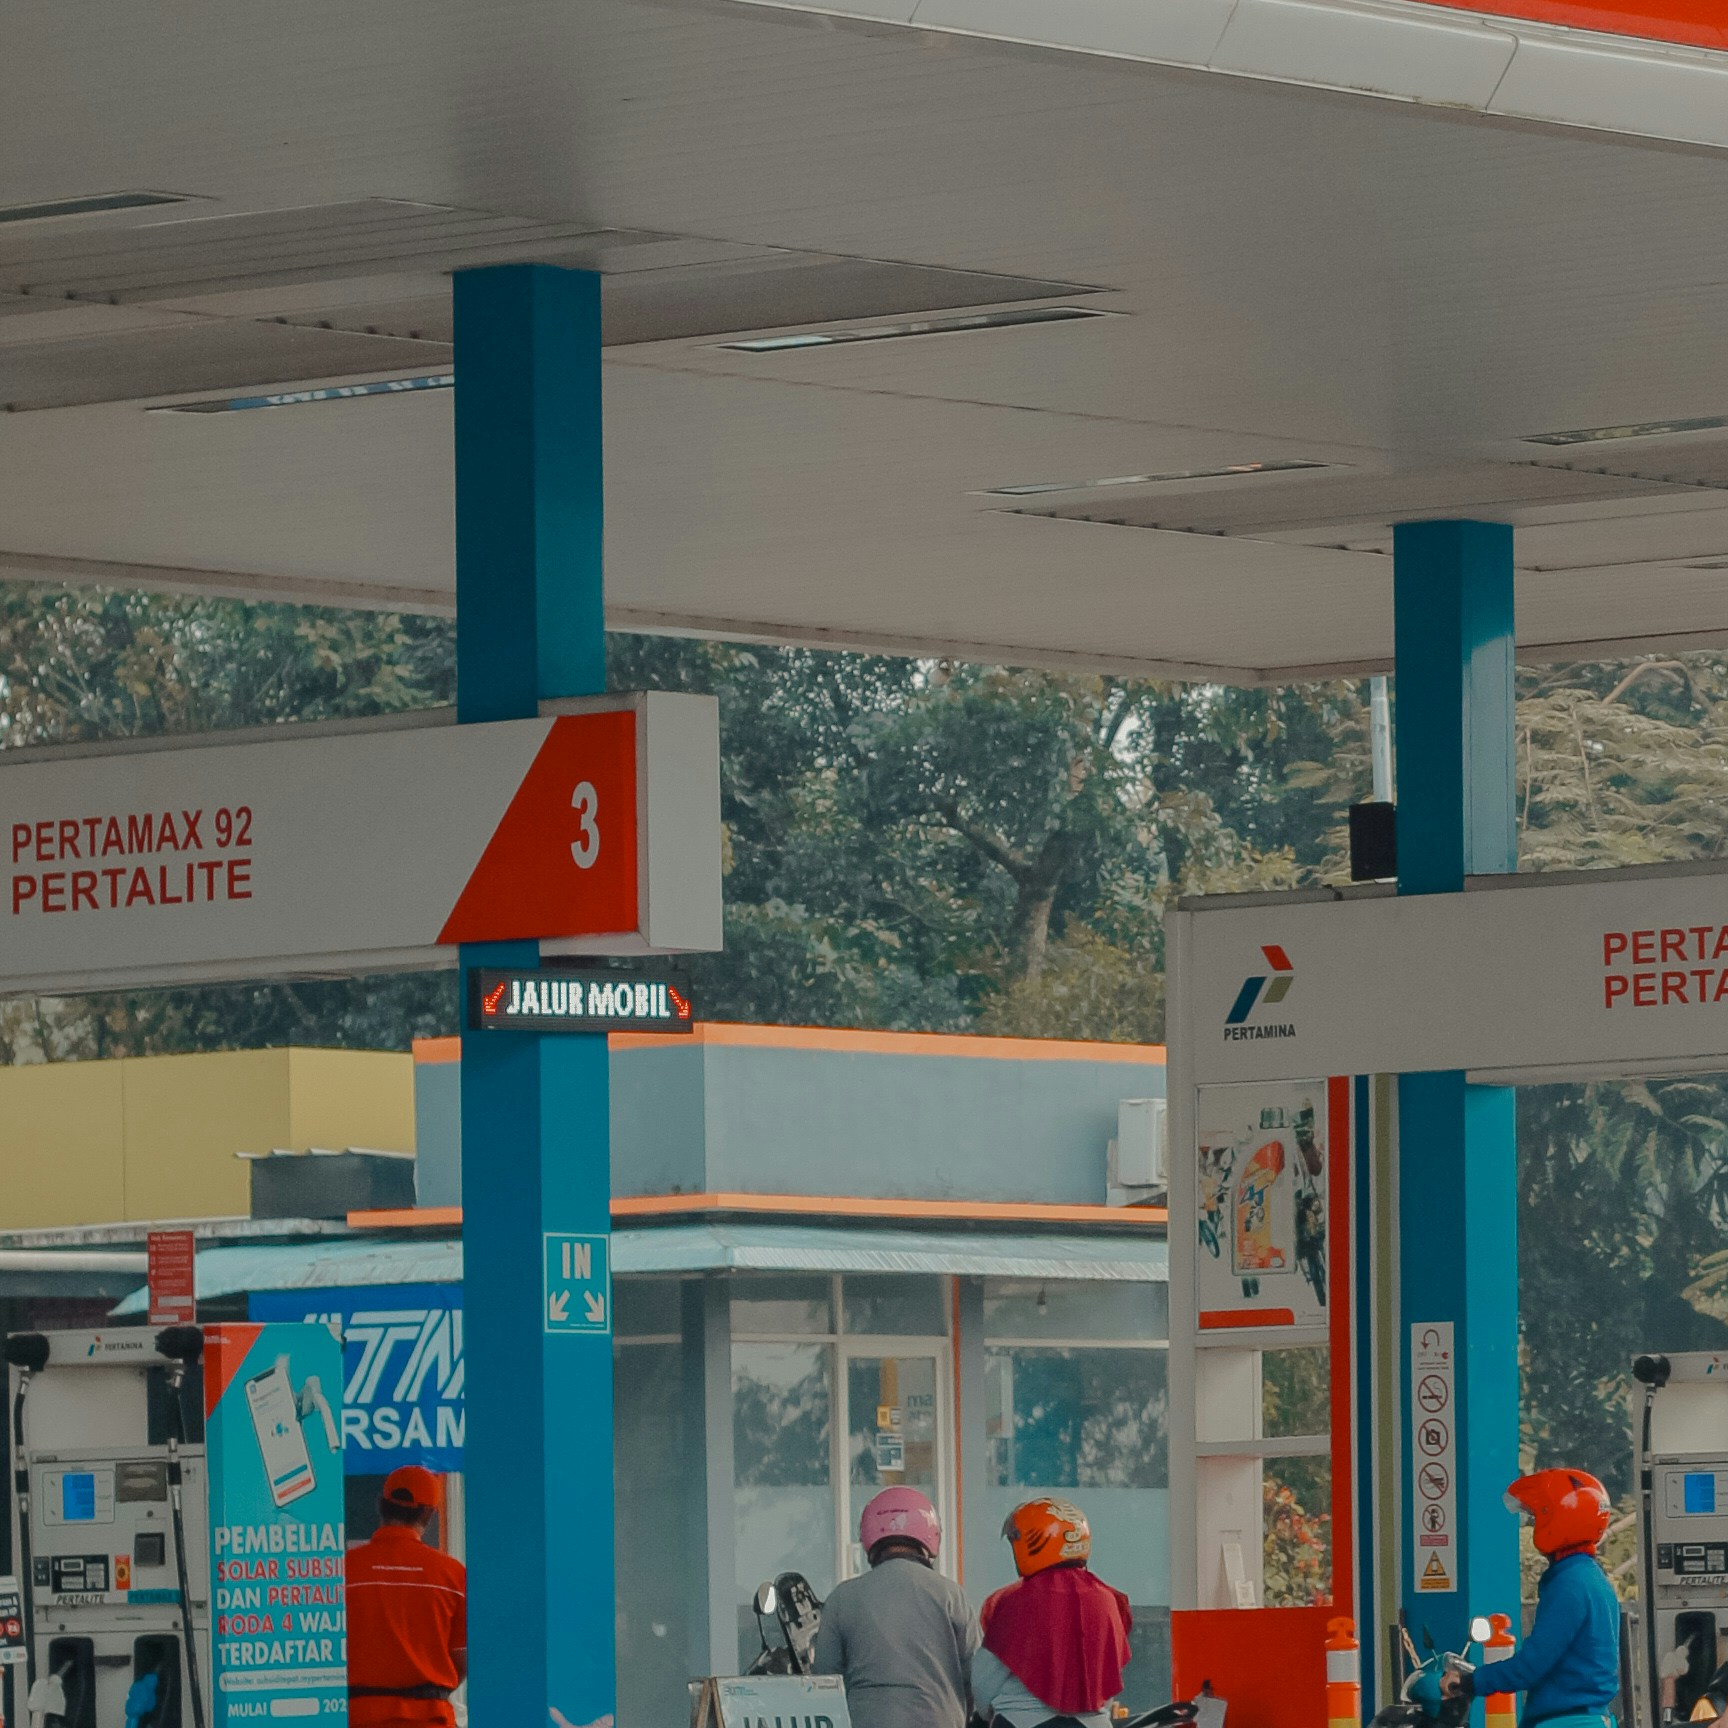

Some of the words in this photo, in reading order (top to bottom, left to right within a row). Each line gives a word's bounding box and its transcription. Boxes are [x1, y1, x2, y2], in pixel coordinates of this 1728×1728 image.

[12, 809, 203, 863] PERTAMAX
[215, 806, 253, 848] 92
[570, 780, 600, 870] 3
[12, 858, 253, 915] PERTALITE
[506, 980, 584, 1016] JALUR
[588, 982, 671, 1018] MOBIL
[1223, 1024, 1296, 1041] PERTAMINA
[562, 1242, 591, 1279] IN
[217, 1559, 278, 1582] SOLAR
[56, 1594, 105, 1605] PERTALITE
[217, 1587, 260, 1610] DAN
[218, 1613, 274, 1636] RODA
[282, 1612, 293, 1633] 4
[218, 1637, 333, 1666] TERDAFTAR
[227, 1702, 267, 1718] MULAI
